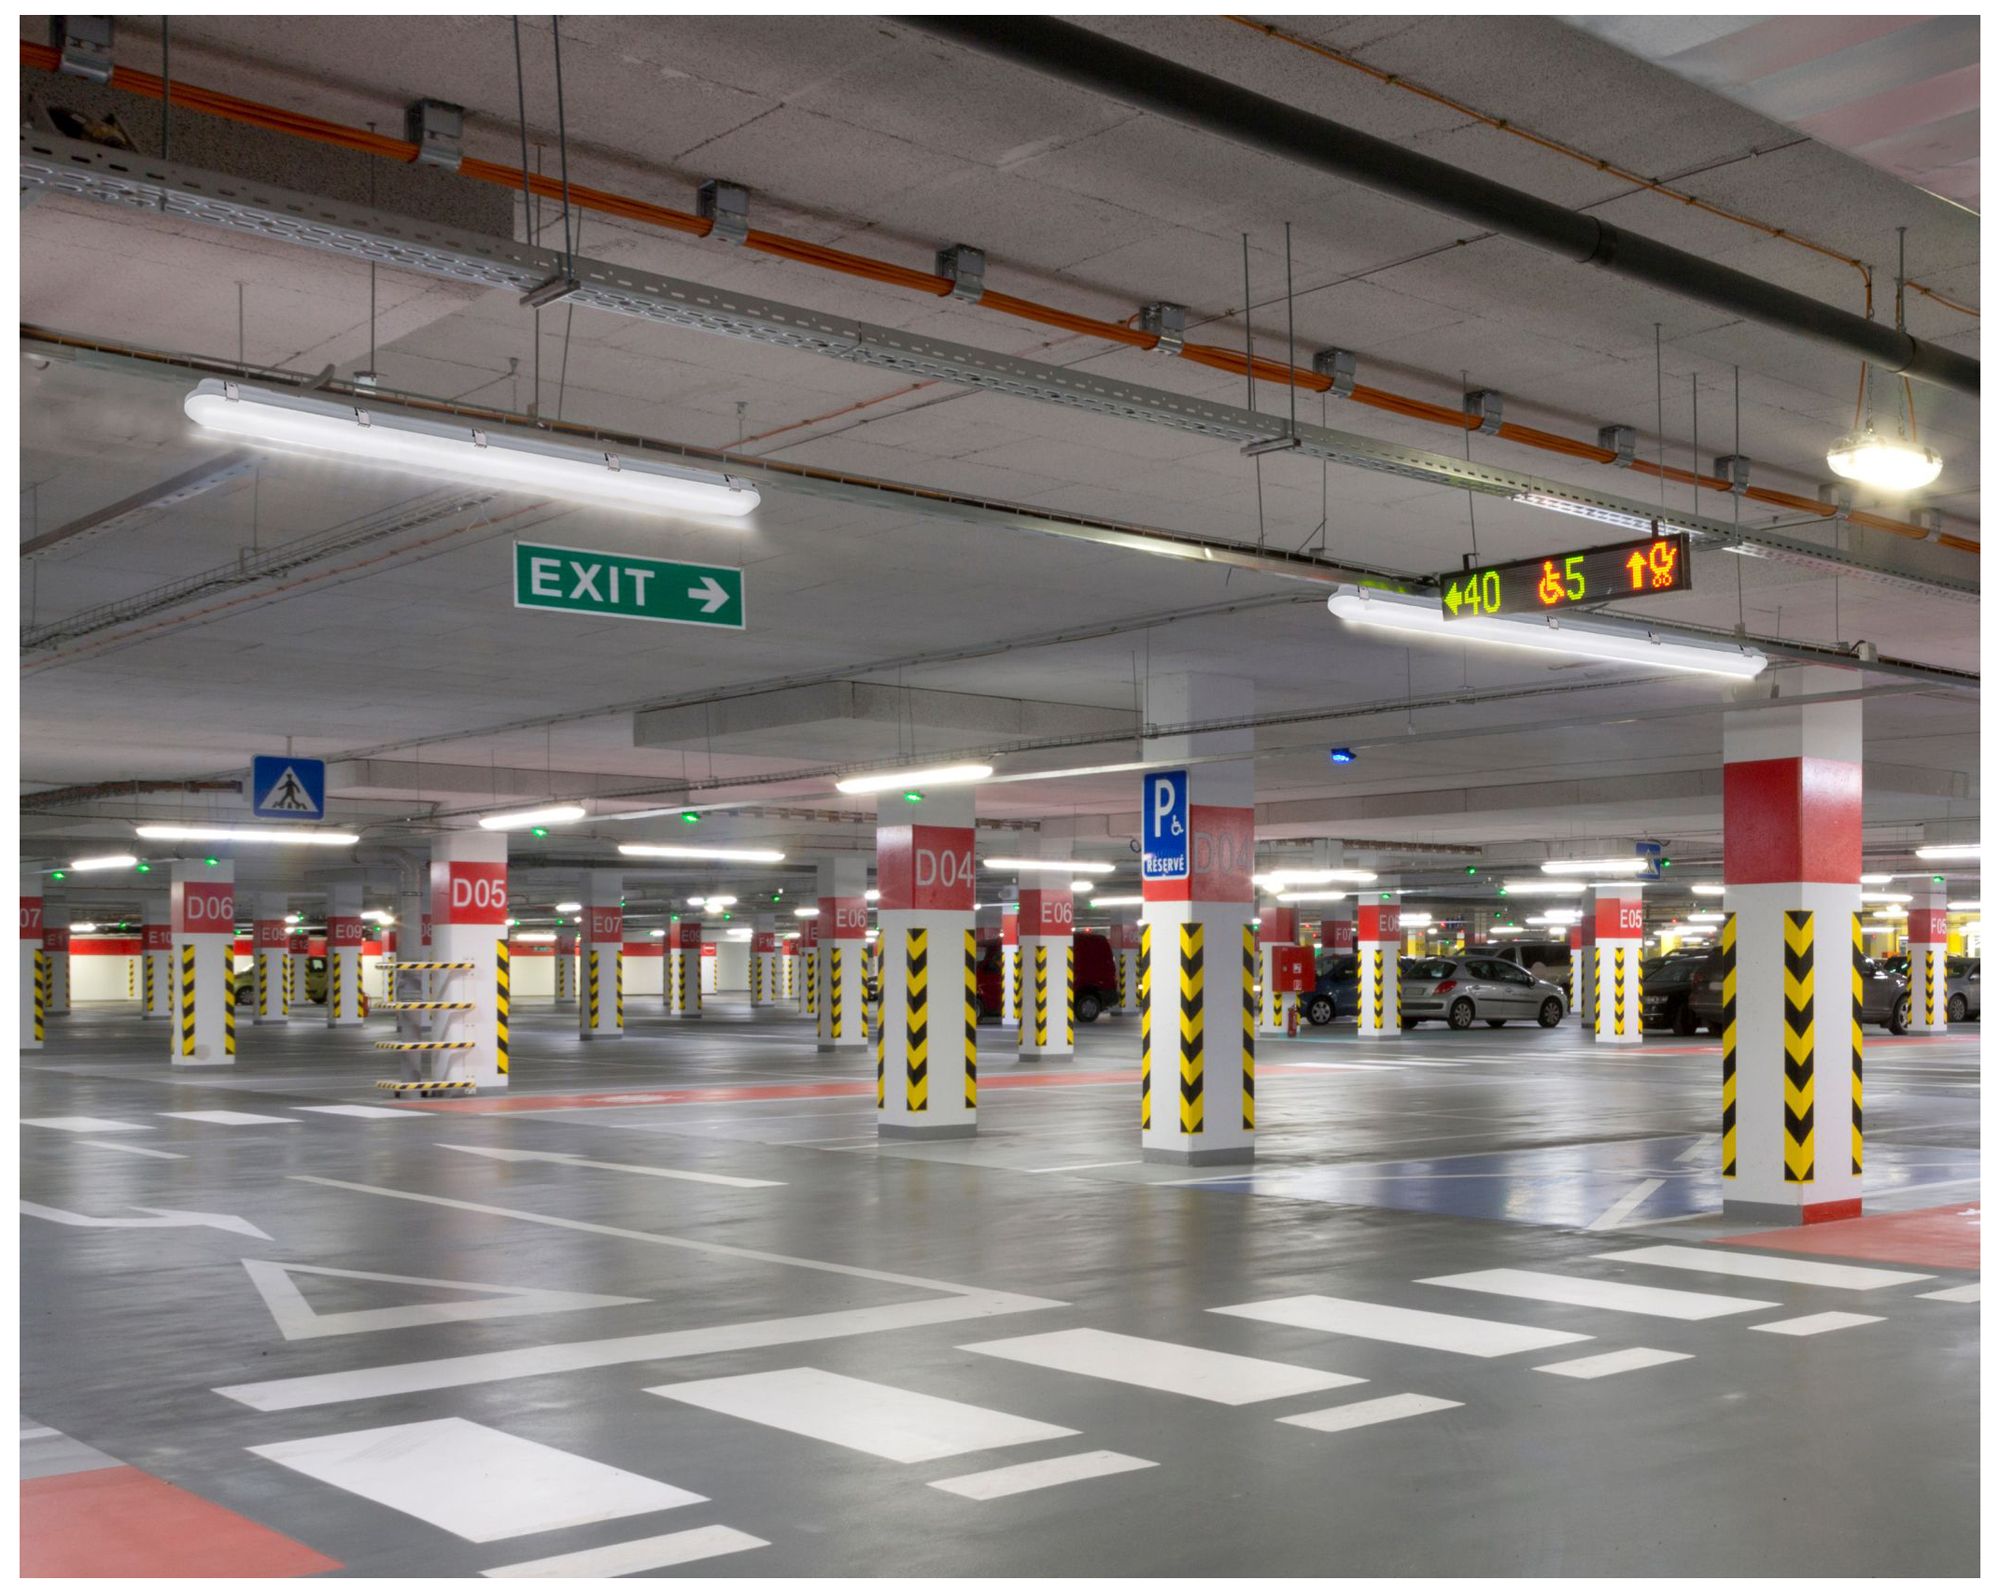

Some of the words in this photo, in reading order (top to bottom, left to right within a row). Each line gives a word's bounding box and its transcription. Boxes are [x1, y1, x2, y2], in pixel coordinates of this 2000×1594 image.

[531, 556, 655, 607] EXIT
[1464, 570, 1501, 616] 40
[1565, 555, 1586, 601] 5
[1154, 778, 1176, 838] P
[1147, 854, 1185, 873] RÉSERVÉ
[1194, 831, 1250, 876] D04
[916, 848, 974, 889] D04
[452, 878, 507, 909] D05
[187, 895, 234, 920] D06
[836, 908, 866, 928] E06
[1041, 902, 1073, 924] E06
[1620, 908, 1642, 929] E05
[335, 923, 362, 939] E09
[592, 915, 621, 934] E07
